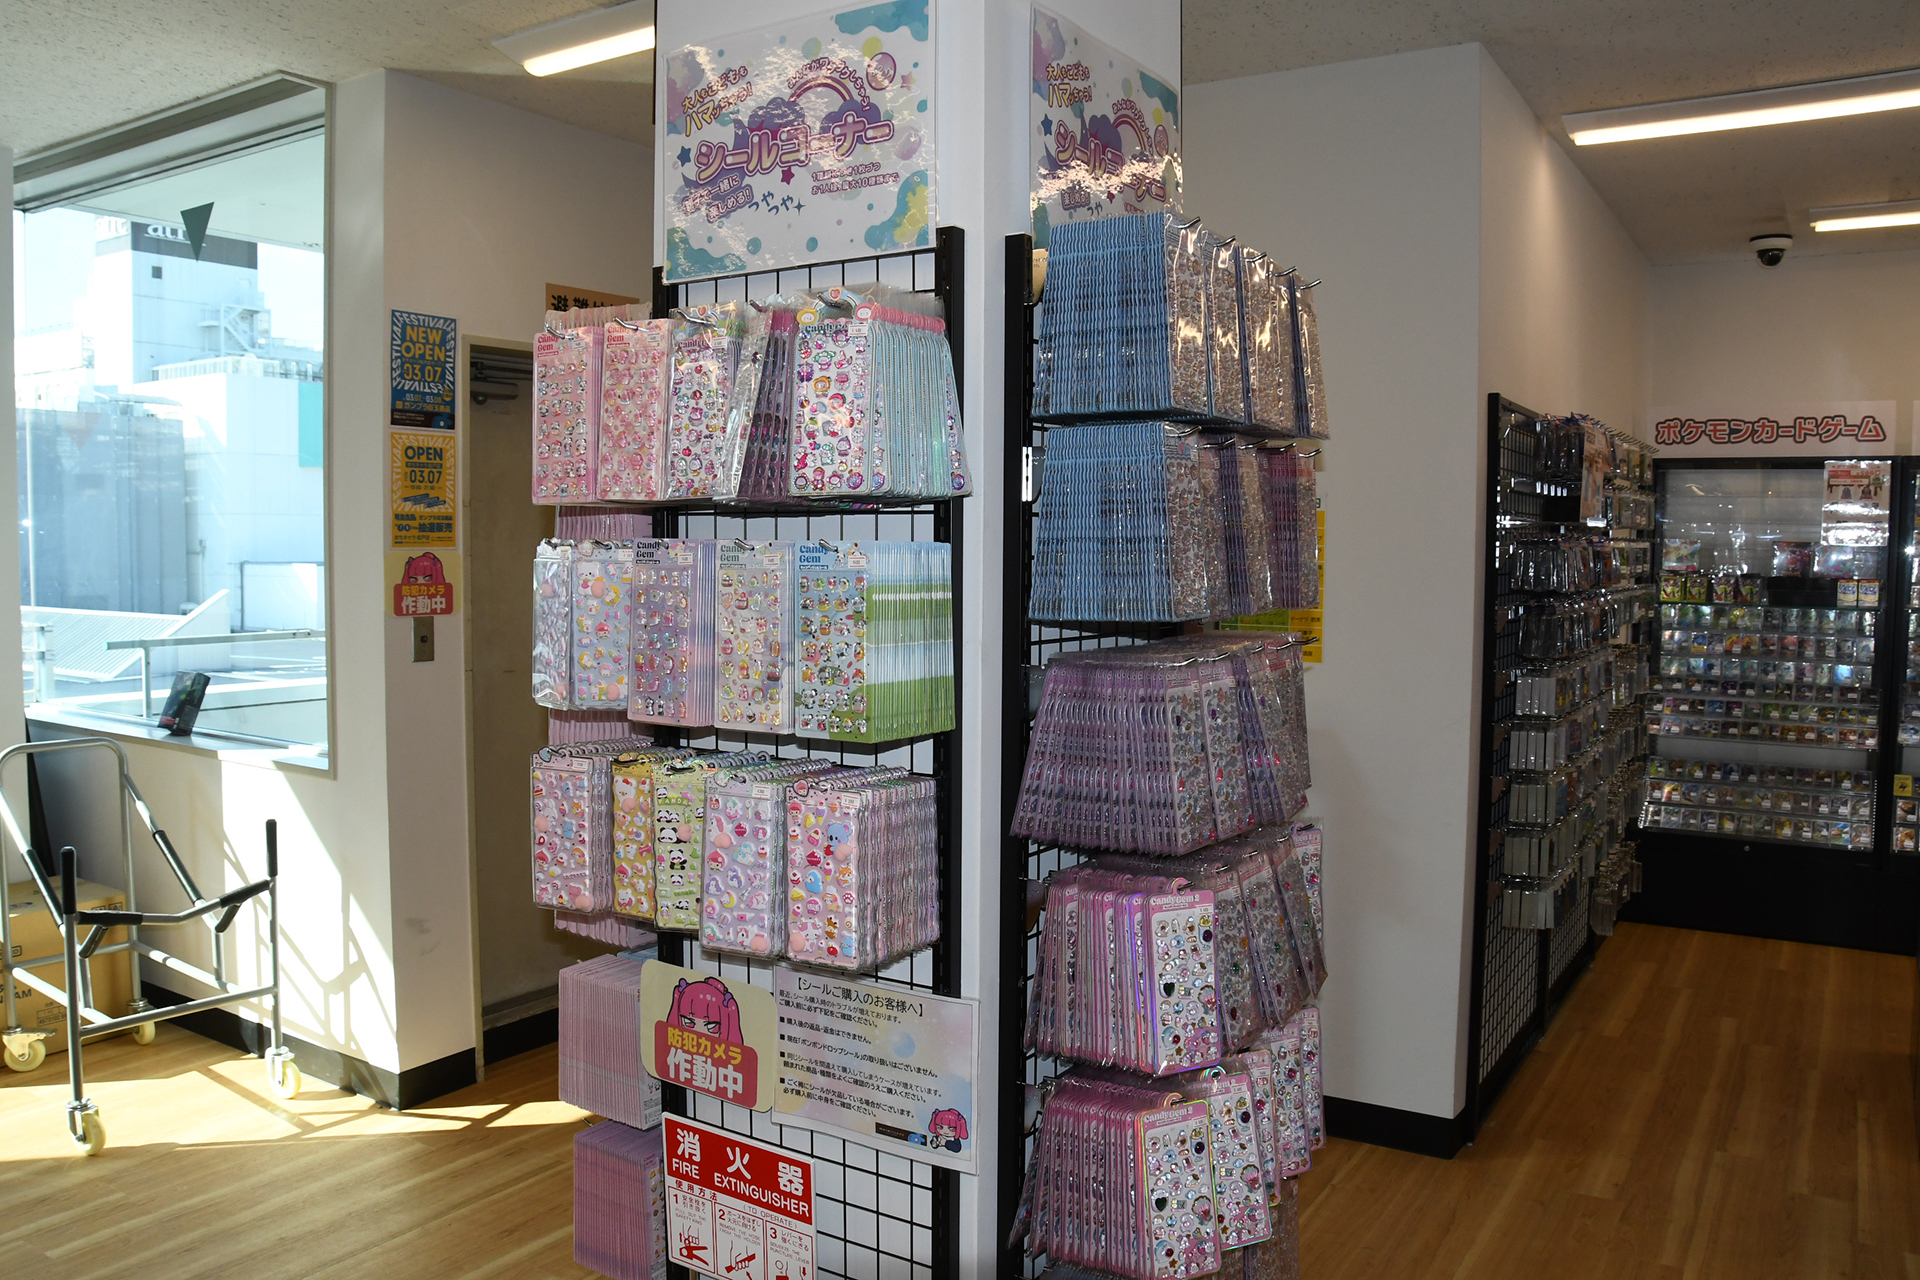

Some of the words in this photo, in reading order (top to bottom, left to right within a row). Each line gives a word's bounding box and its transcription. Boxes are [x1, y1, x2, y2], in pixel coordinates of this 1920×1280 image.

[681, 65, 748, 114] 大人もこどもも
[695, 111, 894, 183] シールコーナー
[406, 325, 443, 345] NEW
[607, 334, 624, 342] Gem
[401, 341, 446, 362] OPEN
[537, 344, 553, 352] Gem
[403, 363, 442, 382] 03.07
[1655, 415, 1887, 445] ポケモンカードゲーム
[404, 445, 443, 461] OPEN
[409, 469, 442, 484] 03.07
[636, 550, 654, 558] Gem
[637, 541, 661, 550] Candy
[720, 553, 740, 562] Gem
[799, 554, 821, 563] Gem
[402, 584, 445, 596] 防犯カメラ
[401, 596, 446, 614] 作動中
[798, 977, 923, 1017] 【シールご購入のお客様へ】
[667, 1027, 742, 1065] 防犯カメラ
[666, 1047, 743, 1100] 作動中
[677, 1128, 804, 1197] 消火器
[672, 1158, 700, 1180] FIRE
[714, 1172, 809, 1218] EXTINGUISHER
[675, 1179, 718, 1202] 使用方法
[673, 1193, 679, 1205] 1
[718, 1208, 726, 1221] 2
[769, 1227, 777, 1240] 3
